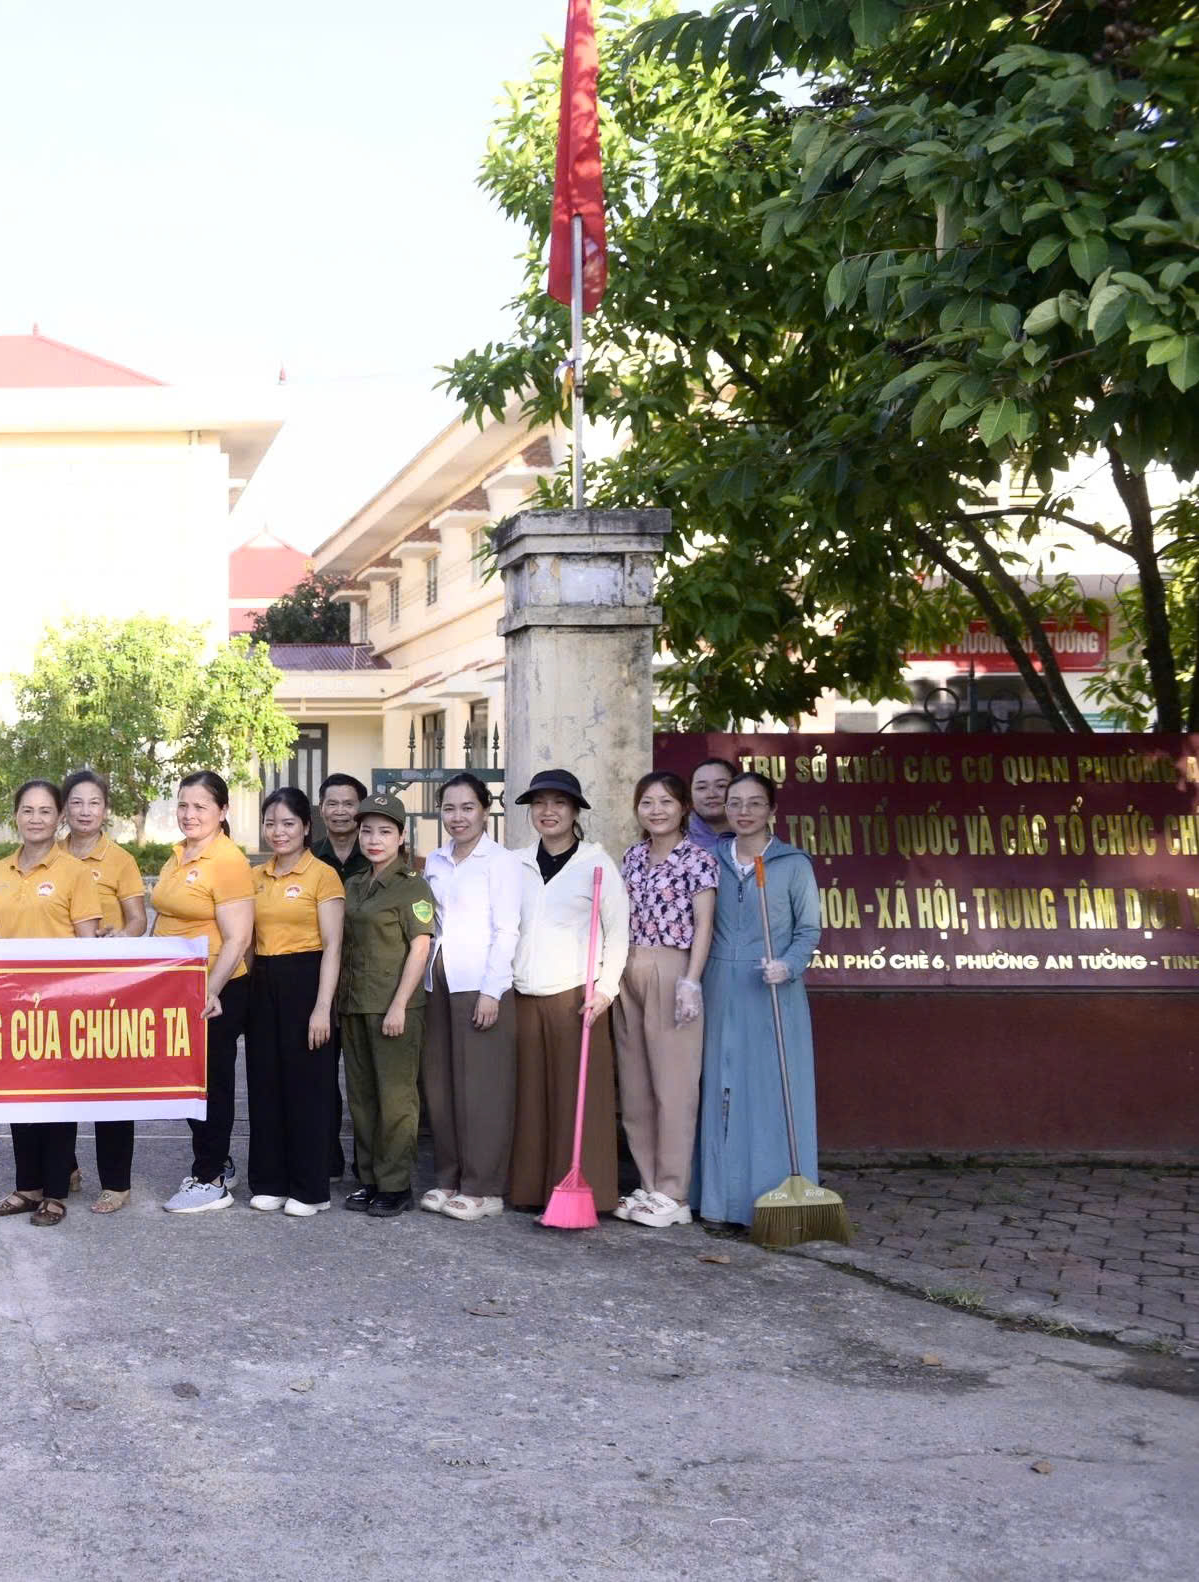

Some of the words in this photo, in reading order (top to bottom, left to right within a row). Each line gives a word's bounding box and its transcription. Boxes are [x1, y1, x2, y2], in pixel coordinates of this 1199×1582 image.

[739, 755, 787, 789] TRỤ
[795, 745, 828, 783] SỞ
[836, 746, 896, 784] KHỐI
[903, 750, 953, 783] CÁC
[960, 753, 994, 783] CƠ
[1002, 756, 1070, 786] QUAN
[786, 806, 853, 864] TRẬN
[896, 801, 960, 860] QUỐC
[964, 806, 996, 855] VÀ
[1000, 805, 1049, 856] CÁC
[1054, 796, 1087, 856] TỔ
[1092, 804, 1157, 856] CHỨC
[875, 880, 912, 929] XÃ
[916, 879, 970, 939] HỘI;
[973, 887, 1058, 930] TRUNG
[1064, 879, 1119, 930] TÂM
[806, 949, 839, 969] ÂN
[844, 946, 886, 970] PHỐ
[889, 949, 930, 970] CHÈ
[956, 948, 1039, 970] PHƯỜNG
[1045, 954, 1073, 970] AN
[1078, 947, 1148, 970] TƯỜNG
[10, 992, 62, 1062] CỦA
[69, 998, 156, 1060] CHÚNG
[163, 1006, 192, 1058] TA
